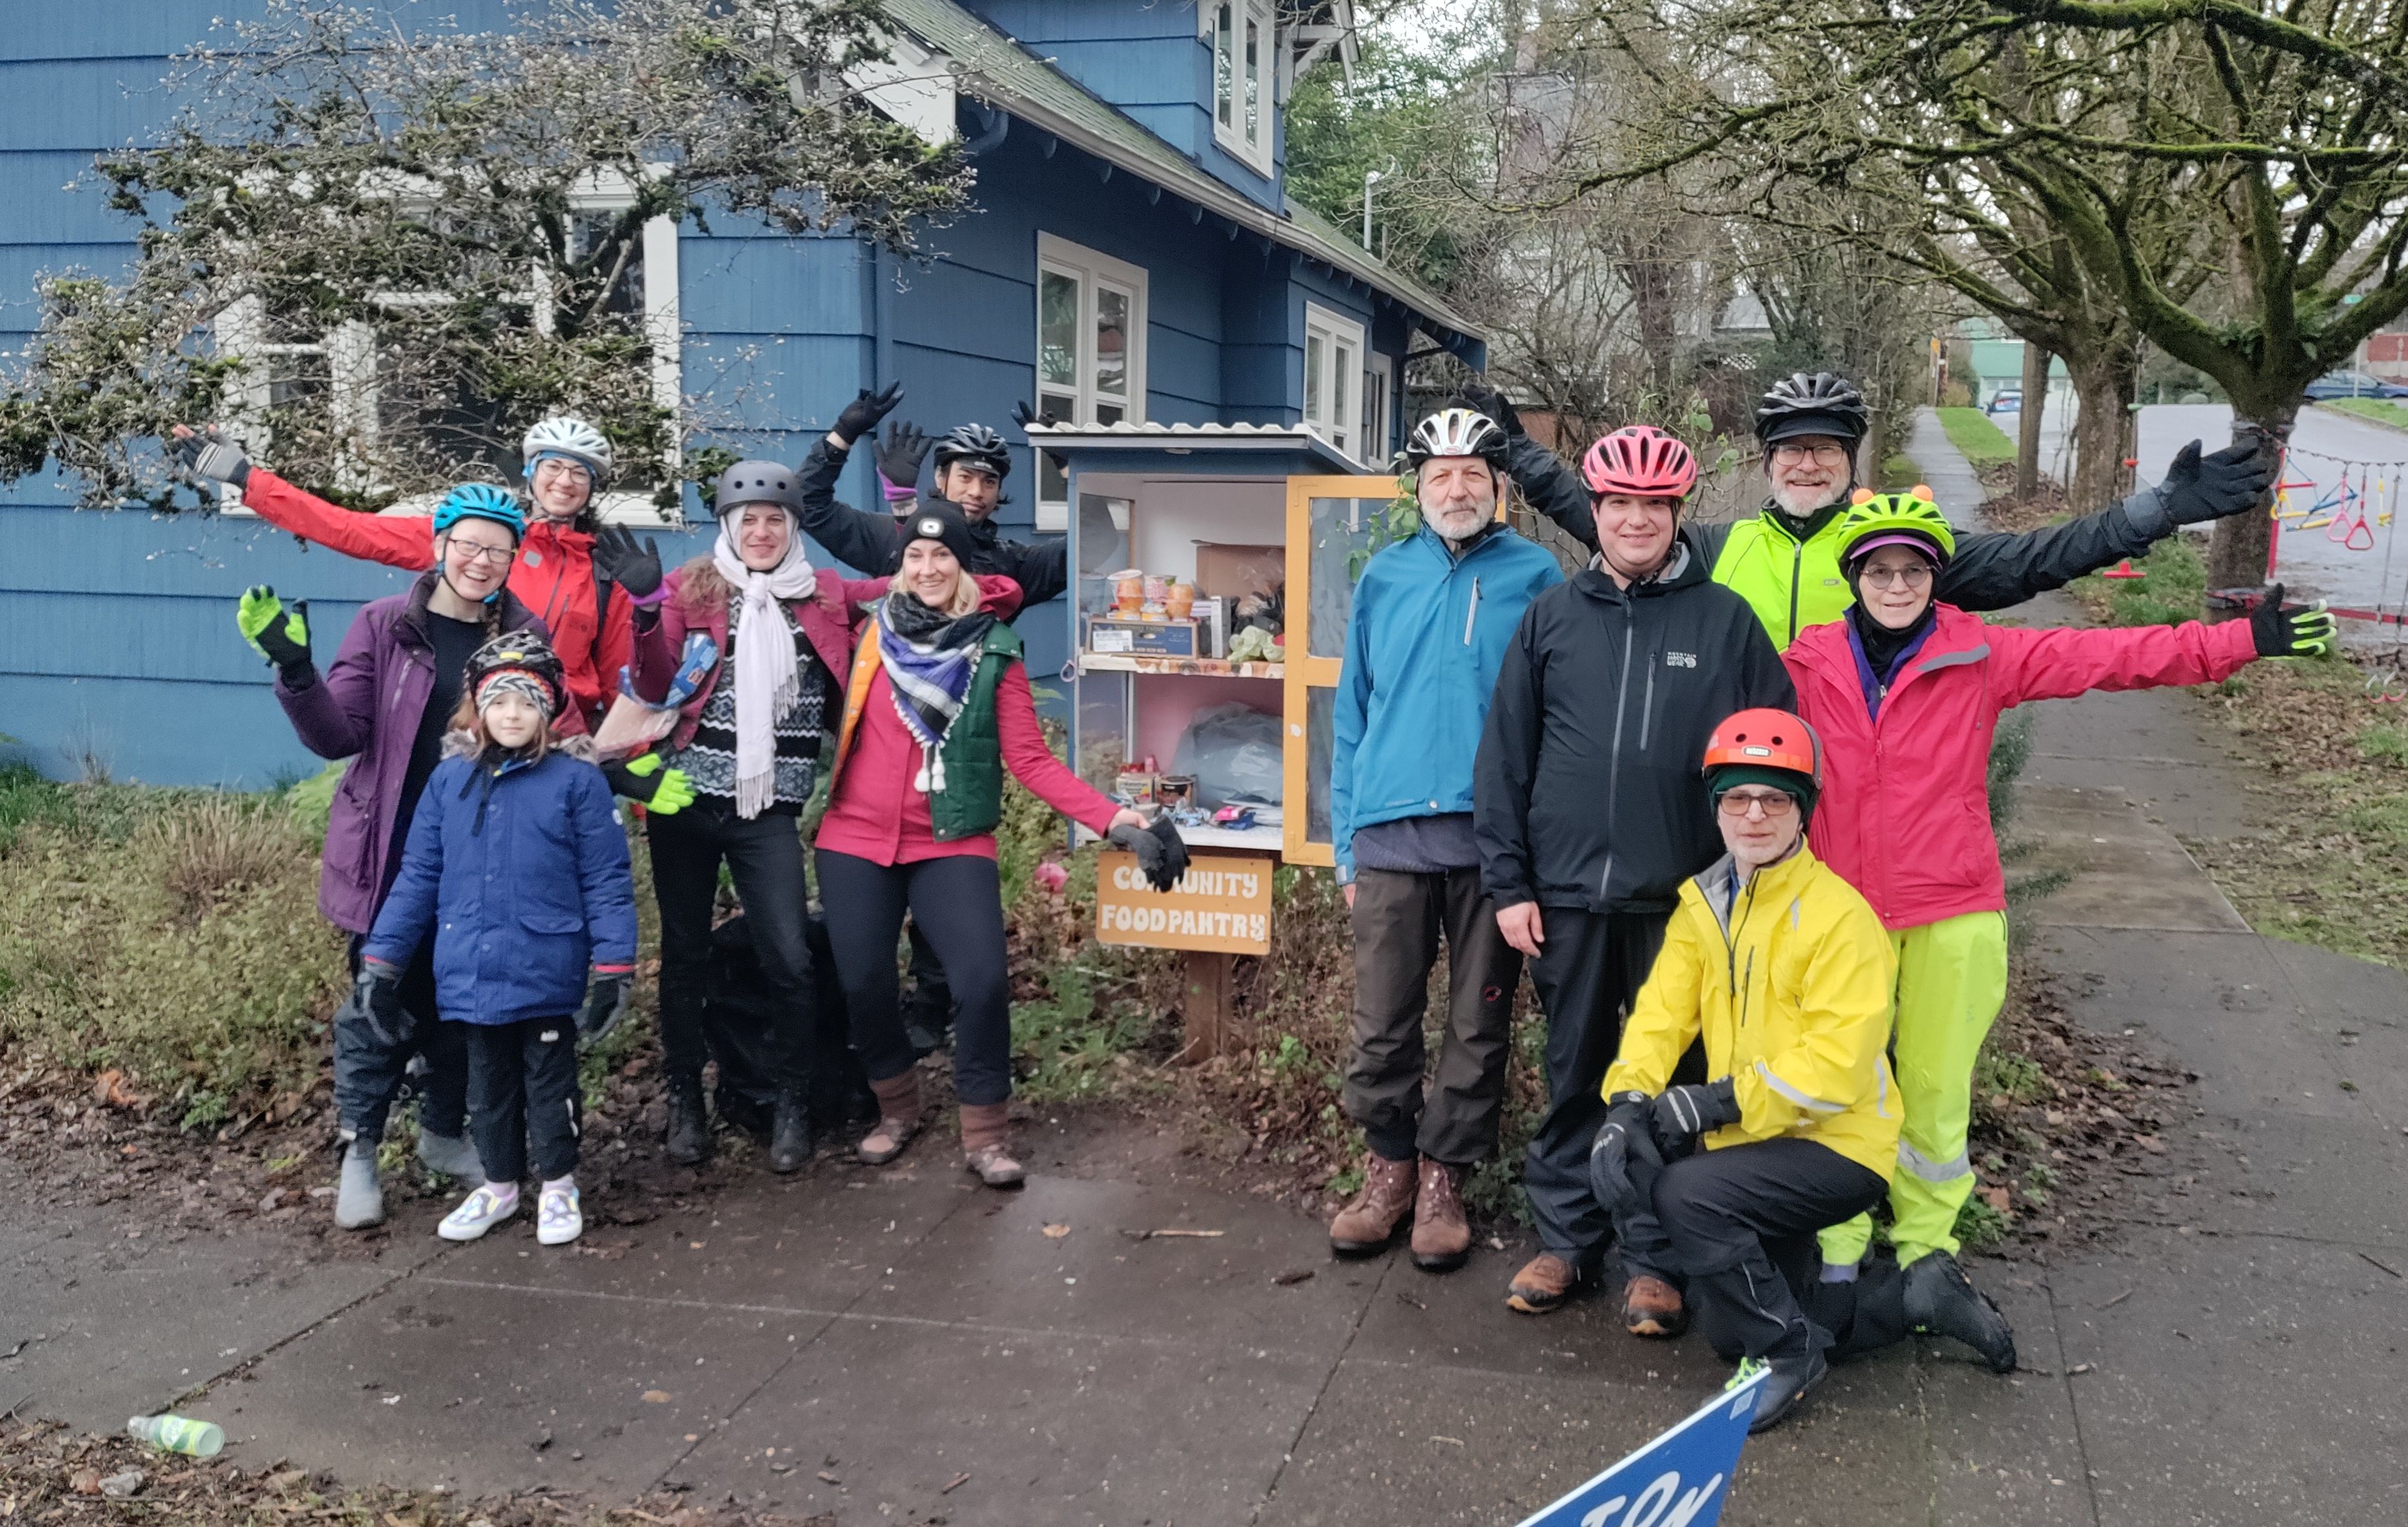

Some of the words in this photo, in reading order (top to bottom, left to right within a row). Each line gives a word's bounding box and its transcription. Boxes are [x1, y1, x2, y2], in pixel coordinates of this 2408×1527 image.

[1113, 865, 1258, 899] COUNITY
[1101, 904, 1167, 932] FOOD
[1168, 909, 1266, 941] PANTRY
